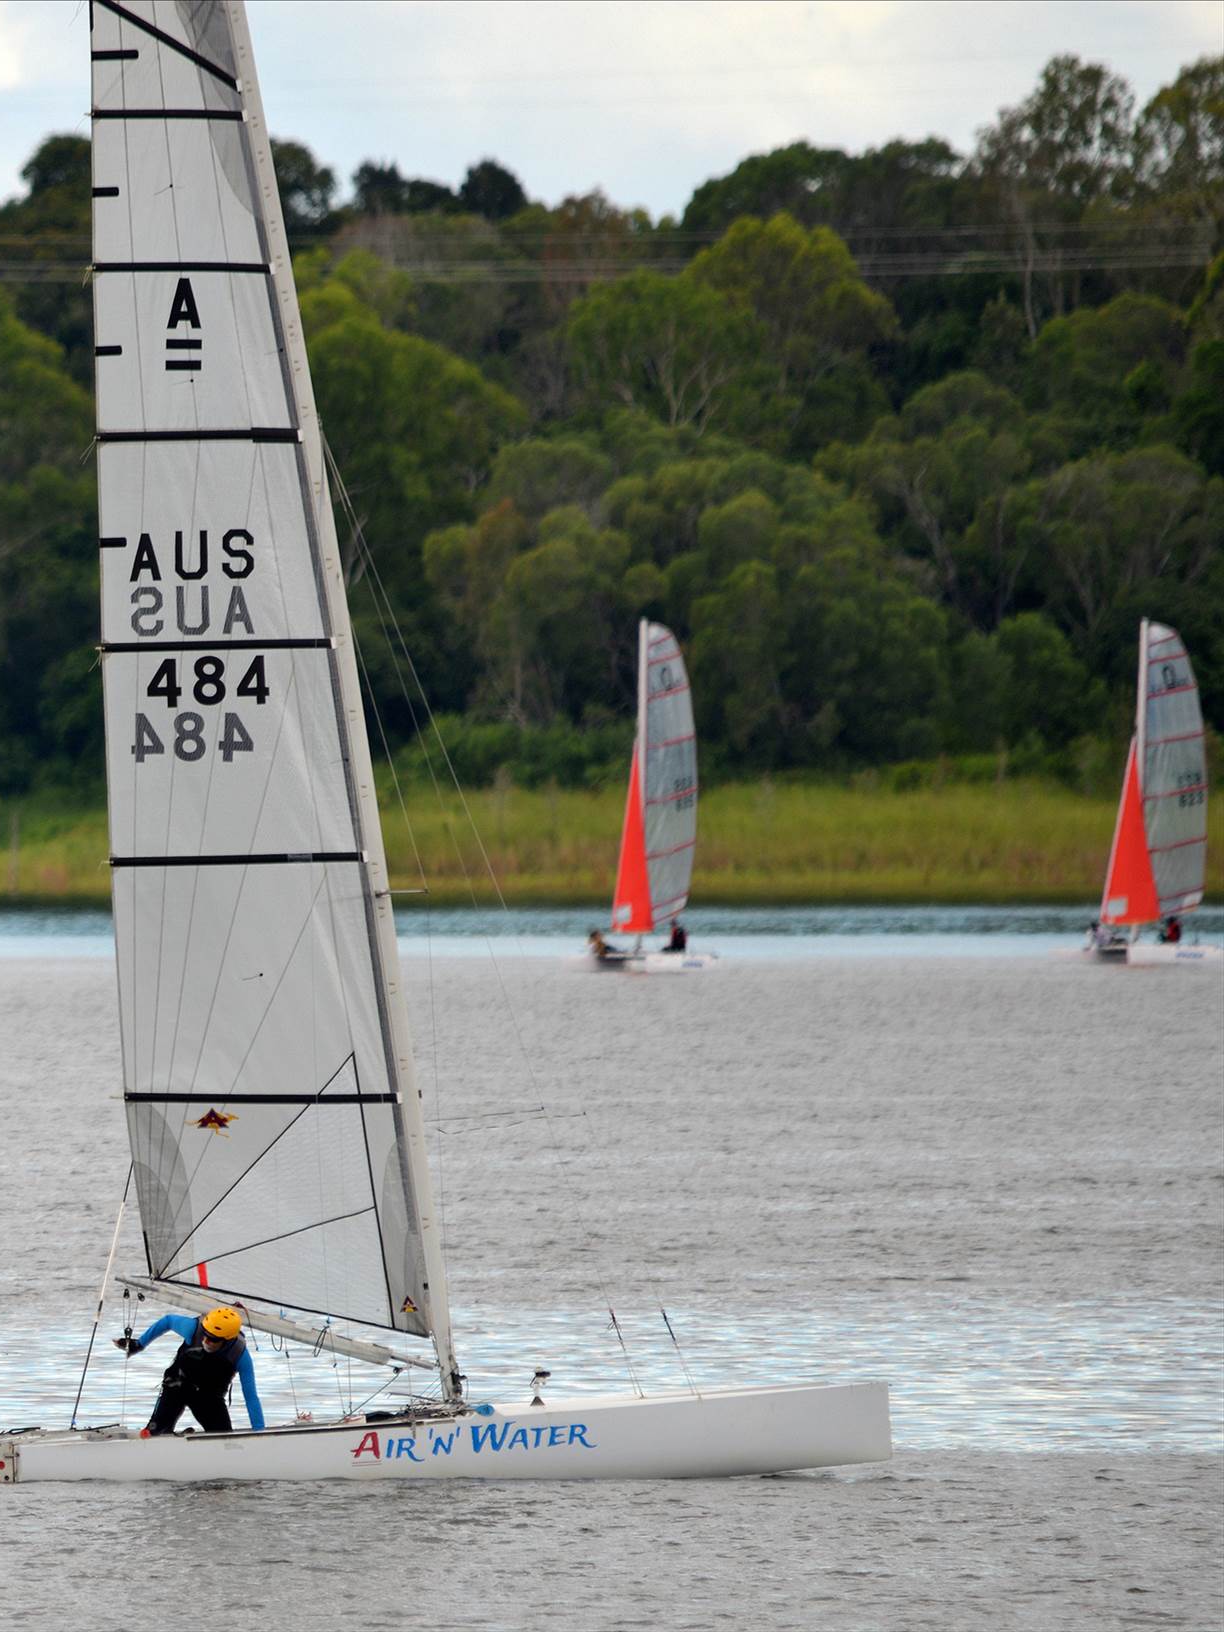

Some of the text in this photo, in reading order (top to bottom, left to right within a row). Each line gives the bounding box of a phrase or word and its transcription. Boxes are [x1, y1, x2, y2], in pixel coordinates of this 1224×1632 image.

[166, 277, 202, 329] A
[129, 528, 255, 582] AUS
[146, 655, 270, 708] 484
[350, 1431, 425, 1463] AIR
[470, 1420, 599, 1454] WATER
